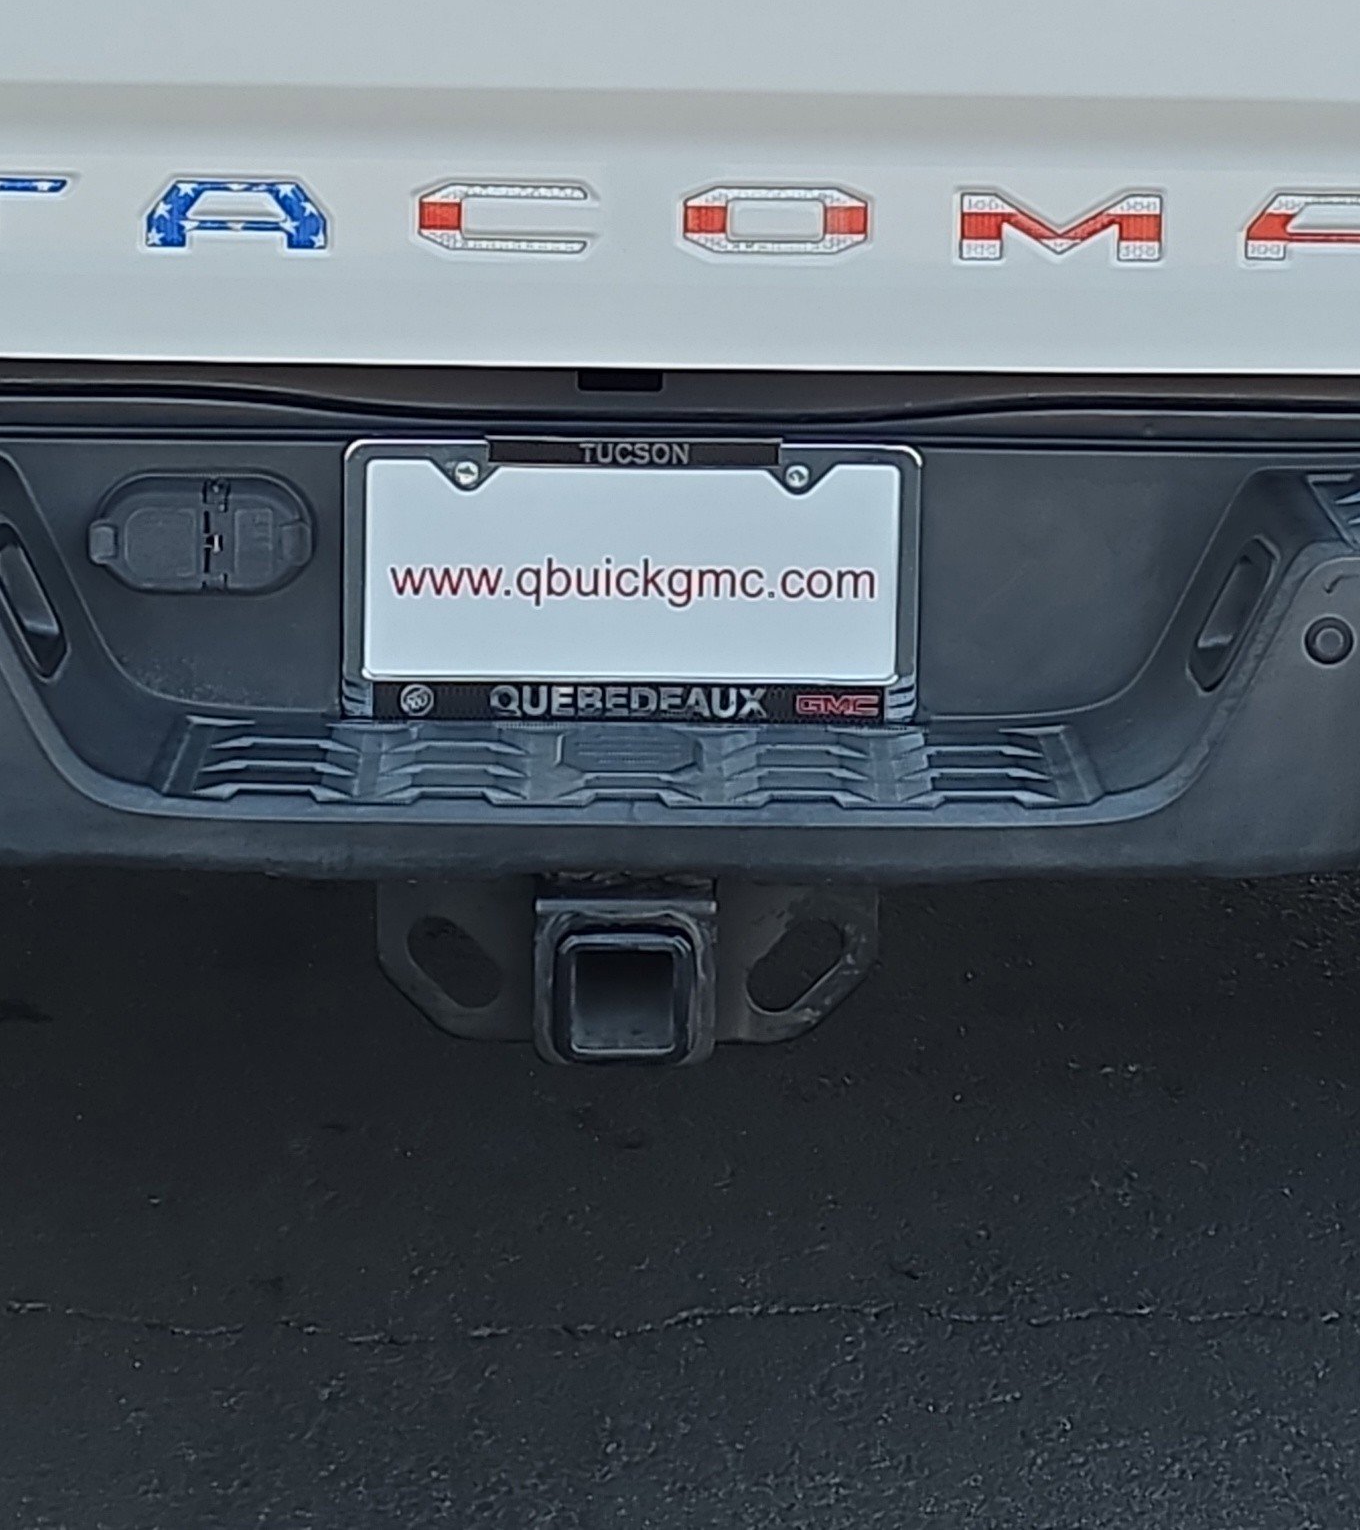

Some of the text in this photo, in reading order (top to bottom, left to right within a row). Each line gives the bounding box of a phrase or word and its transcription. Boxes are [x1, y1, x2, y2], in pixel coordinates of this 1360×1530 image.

[578, 442, 691, 466] TUCSON
[389, 557, 878, 608] www.qbuickgmc.com
[488, 684, 881, 720] QUEBEDEAUX GMC
